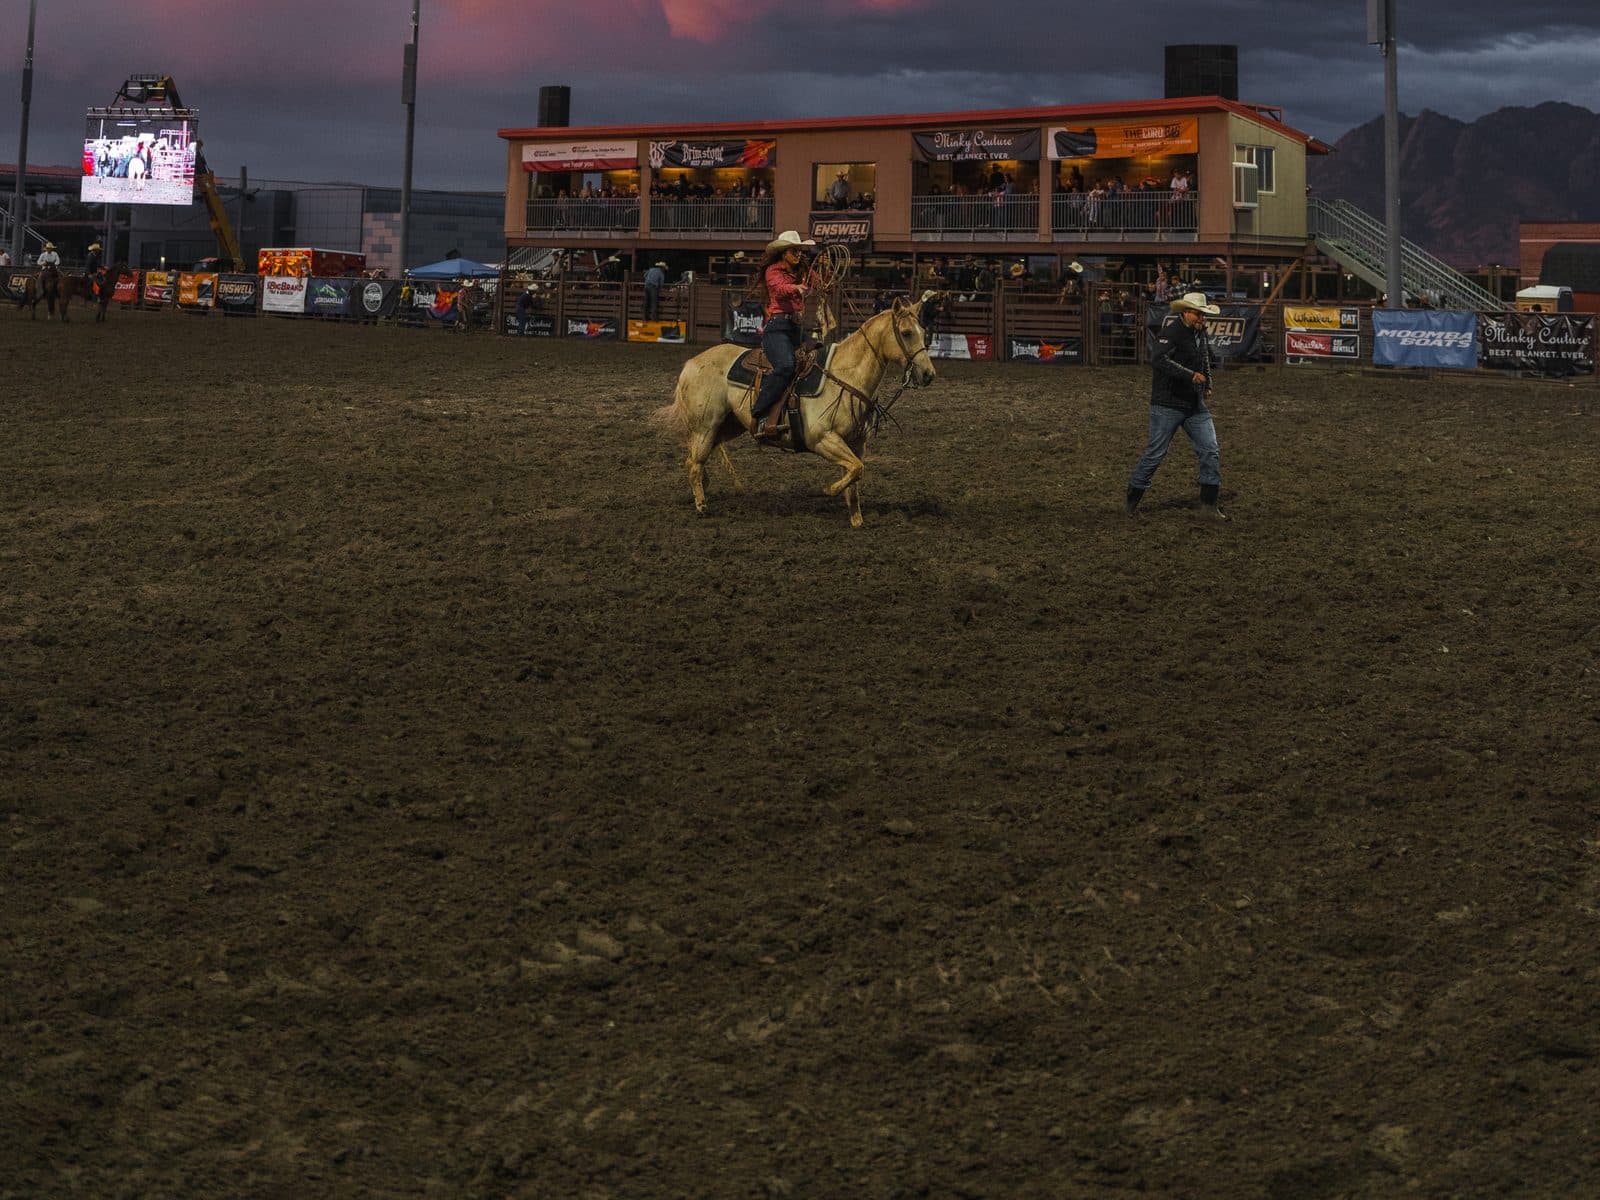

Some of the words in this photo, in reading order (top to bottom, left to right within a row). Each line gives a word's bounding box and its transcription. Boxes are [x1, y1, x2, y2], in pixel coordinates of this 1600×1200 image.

[934, 132, 970, 152] Minky
[969, 130, 1010, 146] Couture
[815, 224, 867, 235] ENSWELL
[219, 283, 253, 294] ENSWELL
[1341, 313, 1357, 325] CAT
[1376, 329, 1472, 341] MOOMBA
[1485, 325, 1536, 349] Minky
[1538, 327, 1589, 345] Couture
[1400, 338, 1472, 348] BOATS
[1489, 349, 1513, 357] BEST.
[1516, 350, 1558, 358] BLANKET.
[1561, 351, 1587, 359] EVER.
